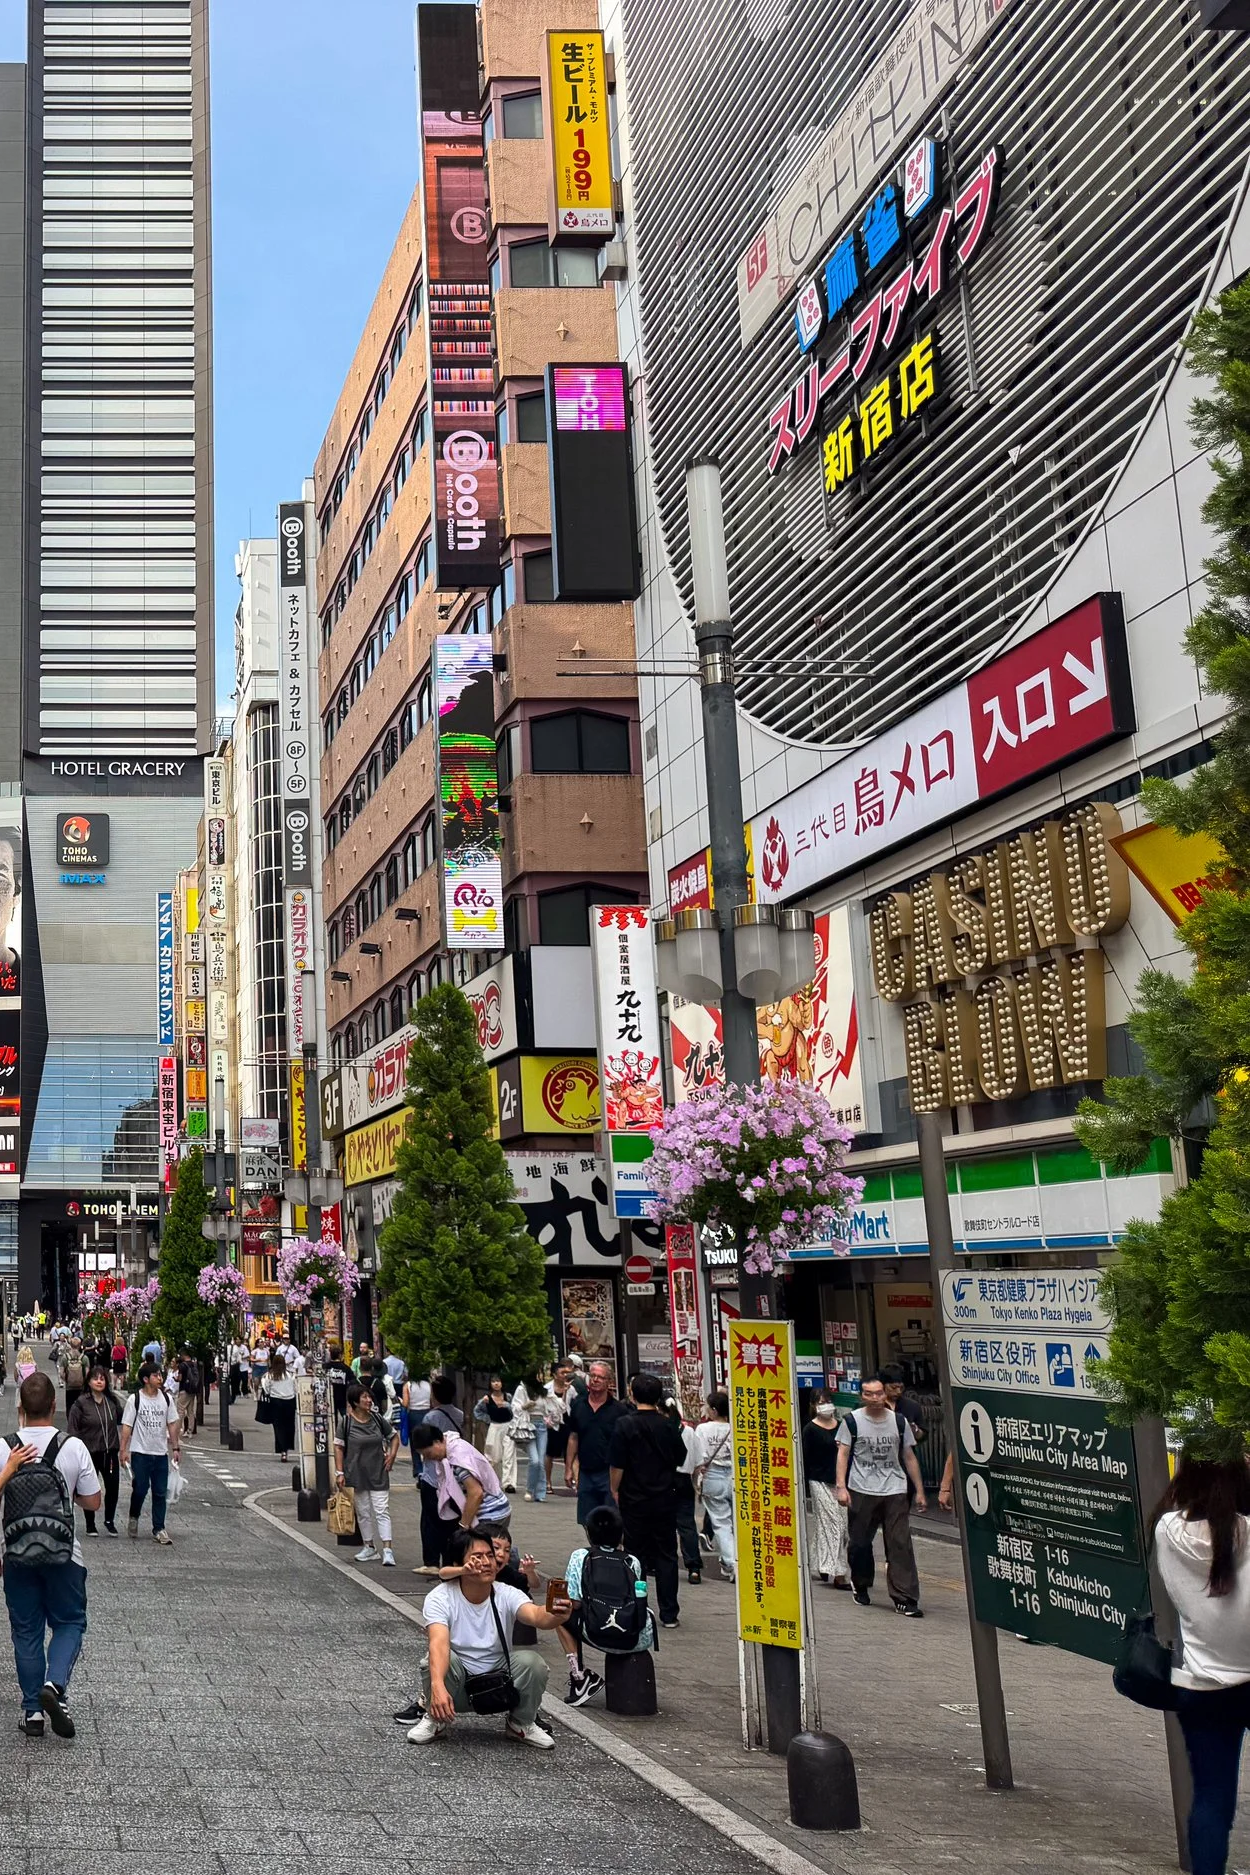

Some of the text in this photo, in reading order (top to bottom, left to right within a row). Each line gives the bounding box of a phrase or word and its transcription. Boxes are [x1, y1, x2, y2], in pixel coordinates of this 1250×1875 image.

[561, 42, 588, 124] 生ビール
[572, 128, 592, 201] 199円
[580, 217, 609, 228] 鳥メロ
[767, 146, 998, 476] スリーファイブ
[823, 333, 937, 495] 新宿店
[443, 429, 490, 552] Booth
[282, 516, 304, 576] Booth
[287, 593, 301, 733] ネットカフェ & カプセル
[982, 667, 1056, 764] 入口
[51, 761, 186, 776] HOTEL GRACERY
[853, 729, 956, 837] 鳥メロ
[211, 771, 221, 805] 東京ビル
[286, 809, 308, 871] Booth
[794, 803, 847, 857] 三代目
[62, 846, 88, 855] TOHO
[62, 855, 98, 863] CINEMAS
[59, 873, 106, 885] IMAX
[870, 801, 1129, 1003] CASINO
[291, 903, 308, 961] カラオケ
[159, 899, 173, 1040] 747 カラオケランド
[618, 933, 632, 986] 個室居酒屋
[615, 990, 643, 1043] 九十九
[324, 1077, 340, 1130] 3F
[500, 1080, 518, 1121] 2F
[245, 1166, 278, 1177] DAN
[83, 1204, 117, 1216] TOHO
[964, 1215, 1041, 1232] 歌舞伎町セントラルロード店
[704, 1249, 738, 1265] TSUKU
[978, 1277, 1100, 1303] 東京都健康プラザハイジア
[954, 1306, 1093, 1323] 300m Tokyo Kenko Plaza Hygeia
[741, 1342, 776, 1366] 警告
[959, 1338, 1037, 1367] 新宿区役所
[961, 1366, 1041, 1385] Shinjuku City Office
[995, 1416, 1108, 1450] 新宿区エリアマップ
[768, 1388, 794, 1557] 不法投棄厳禁
[997, 1440, 1128, 1480] Shinjuku City Area Map
[996, 1533, 1035, 1563] 新宿区
[1044, 1544, 1070, 1567] 1-16
[986, 1554, 1037, 1589] 歌舞伎町
[1047, 1566, 1112, 1600] Kabukicho
[1009, 1587, 1041, 1616] 1-16
[1049, 1589, 1127, 1631] Shinjuku City
